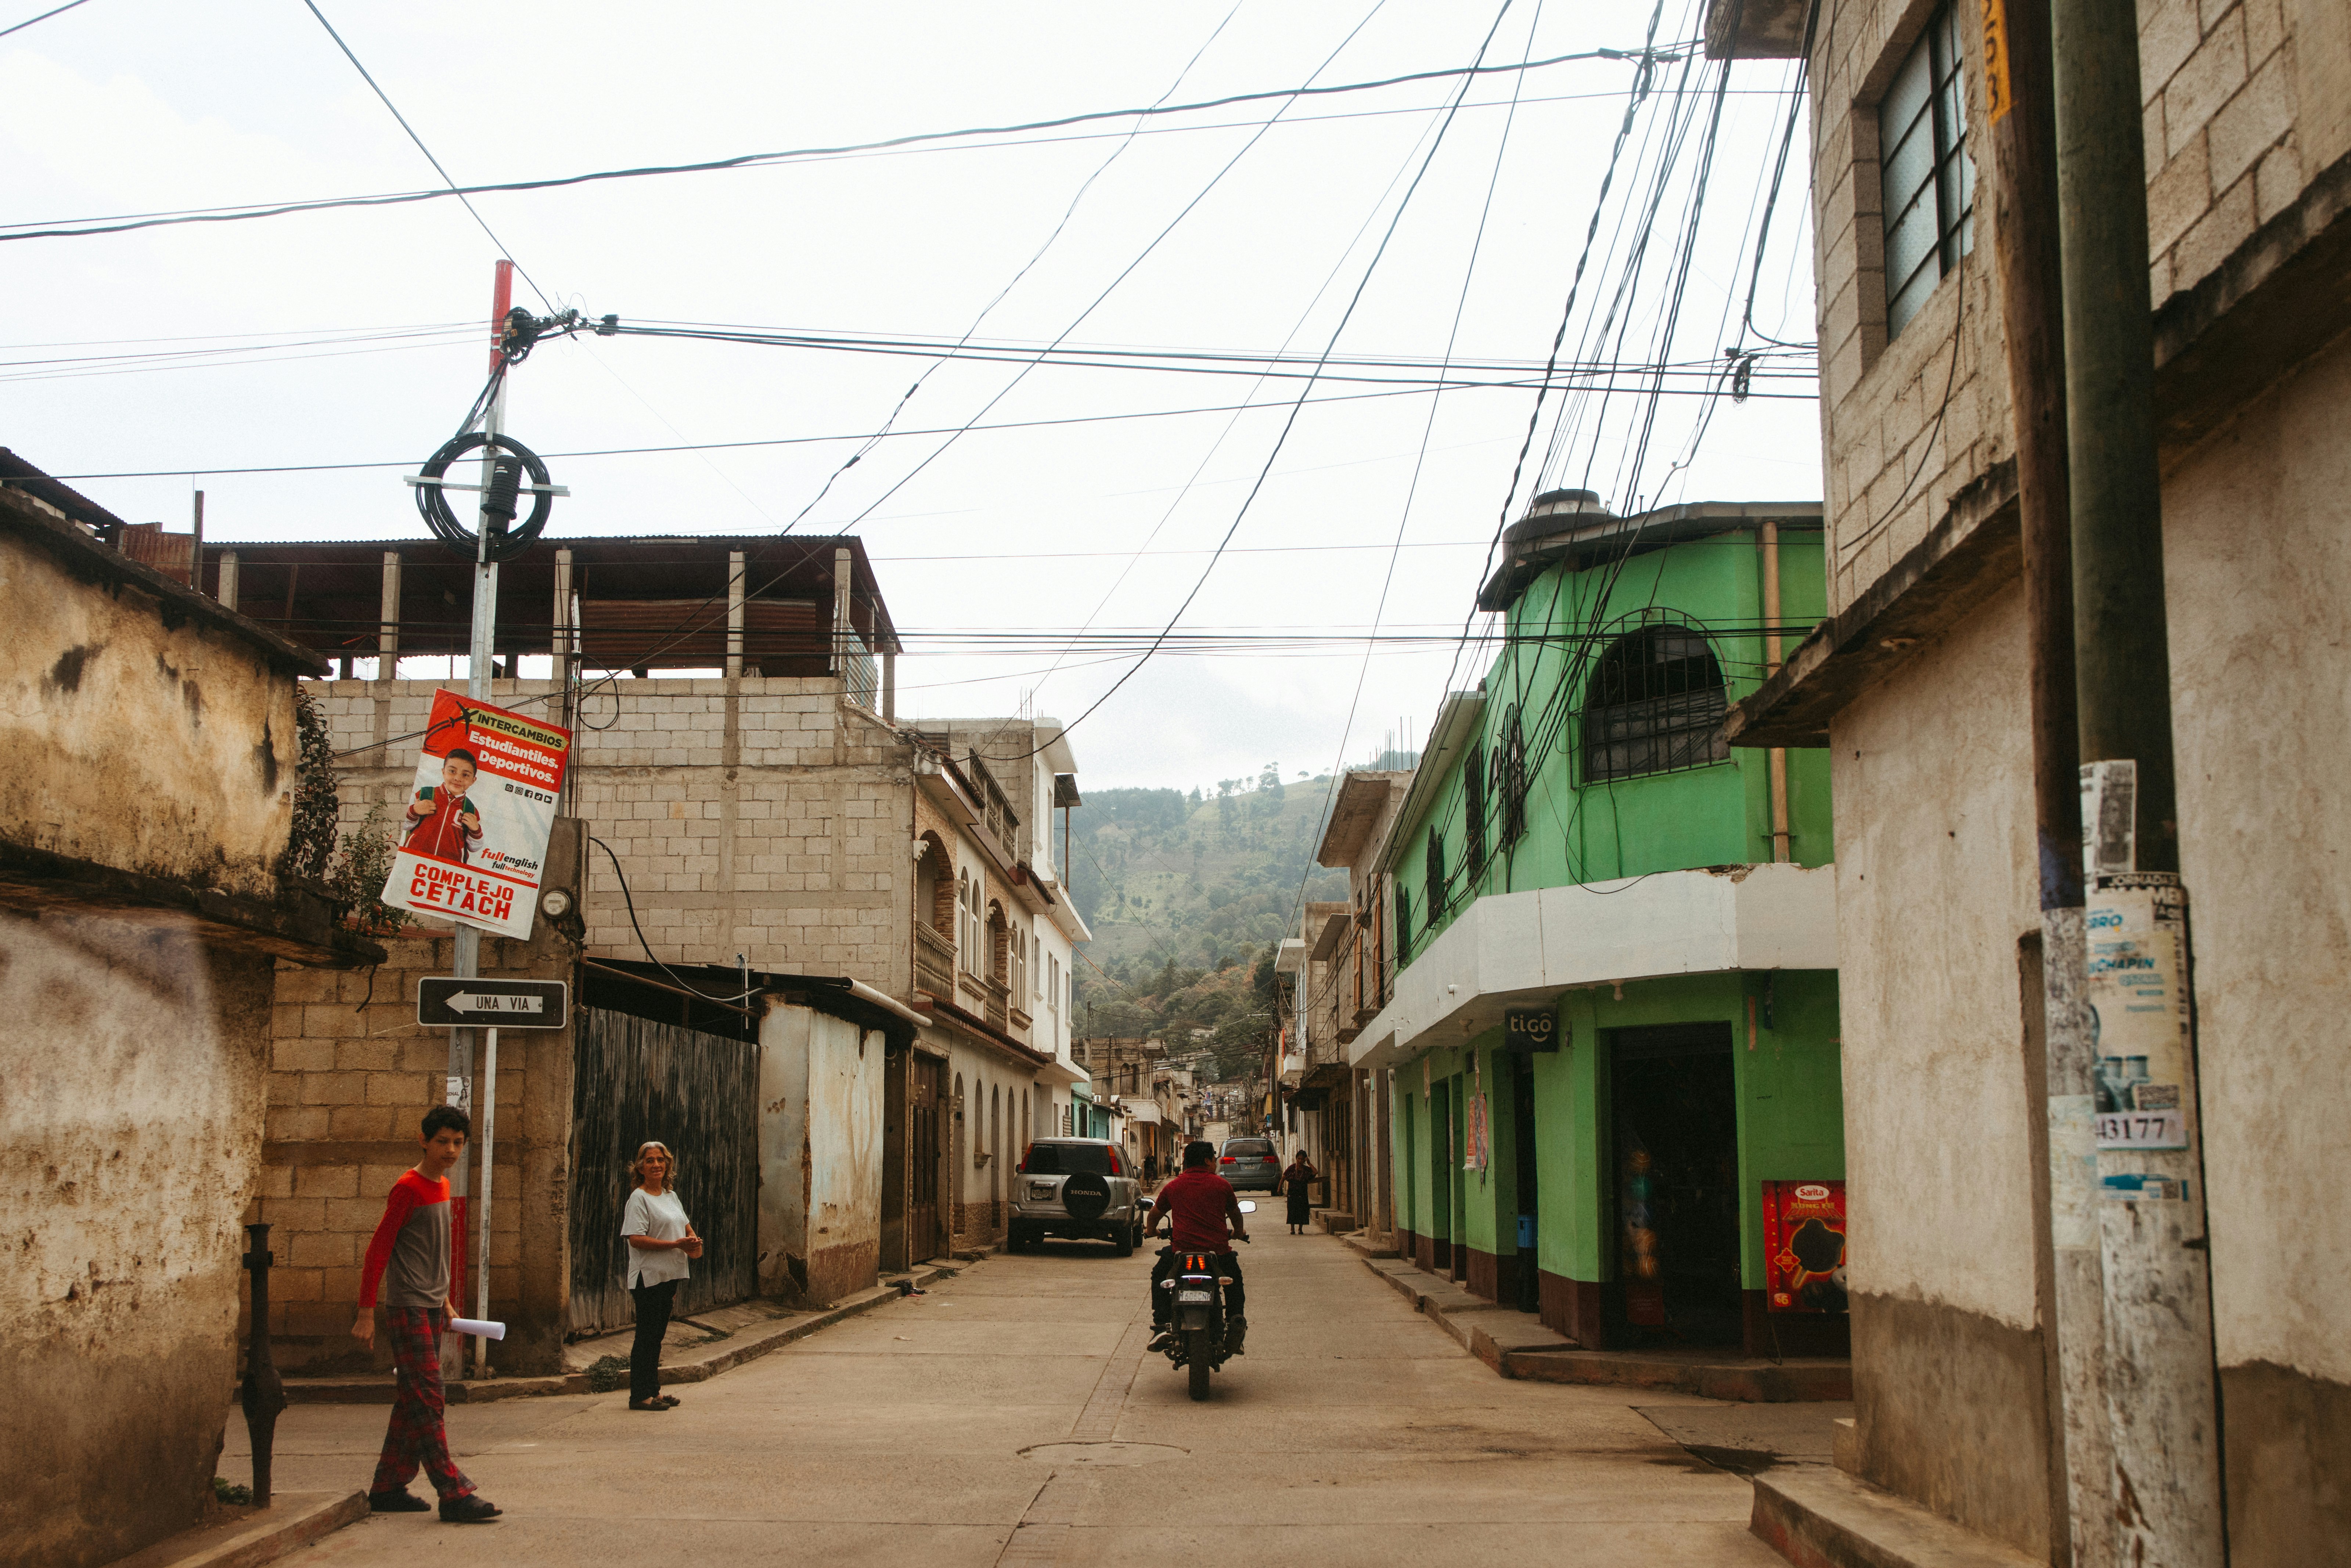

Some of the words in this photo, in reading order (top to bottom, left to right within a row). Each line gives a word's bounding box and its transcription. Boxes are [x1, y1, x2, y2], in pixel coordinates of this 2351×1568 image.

[477, 714, 562, 748] INTERCAMBIOS
[469, 731, 558, 768] Estudiantiles.
[479, 750, 555, 783] Deportivos.
[410, 878, 511, 920] CETACH
[414, 863, 514, 901] COMPLEJO
[476, 996, 499, 1009] UNA
[510, 997, 529, 1010] VIA
